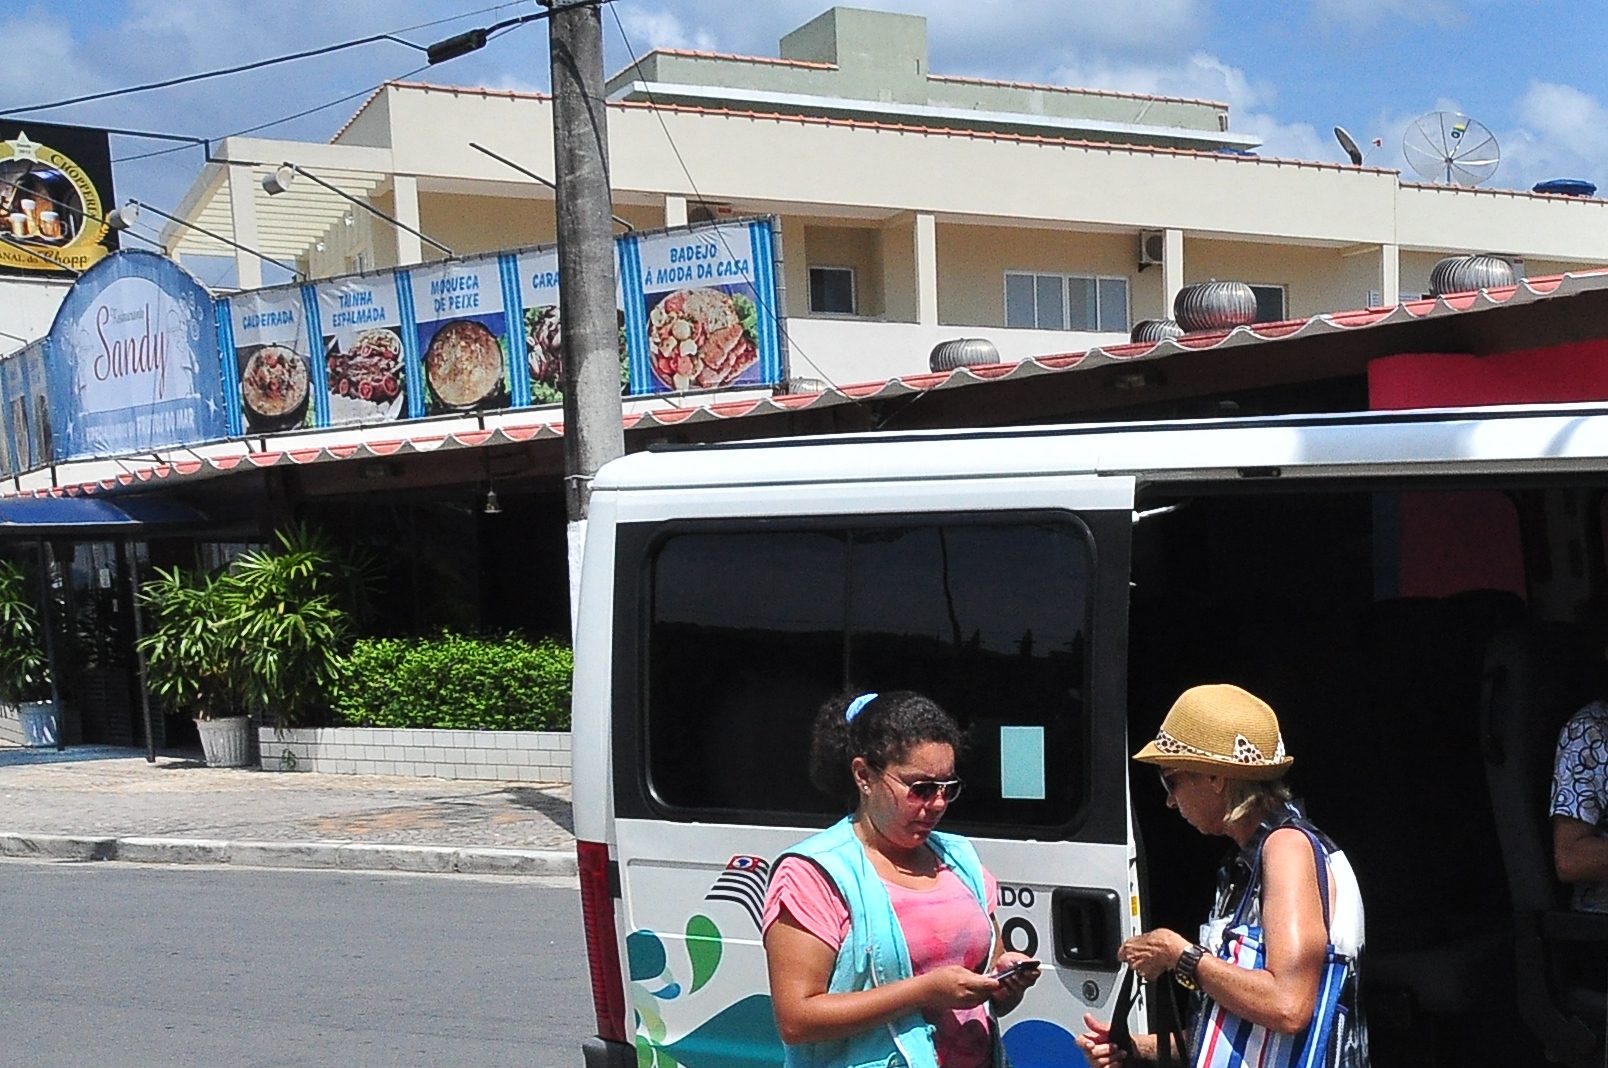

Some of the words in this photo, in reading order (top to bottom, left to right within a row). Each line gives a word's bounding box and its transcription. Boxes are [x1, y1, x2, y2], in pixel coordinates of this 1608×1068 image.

[51, 153, 98, 218] CHOPPERI
[670, 243, 717, 263] BADEJO
[657, 265, 692, 284] MODA
[697, 263, 713, 279] DA
[716, 258, 749, 277] CASA
[431, 274, 479, 295] MOQUECA
[338, 290, 373, 309] TAINHA
[434, 297, 446, 312] DE
[448, 292, 479, 311] PEIXE
[242, 309, 294, 330] CALDEIRADA
[332, 306, 386, 328] ESPALMADA
[94, 304, 166, 399] Sandy
[997, 886, 1035, 908] DO
